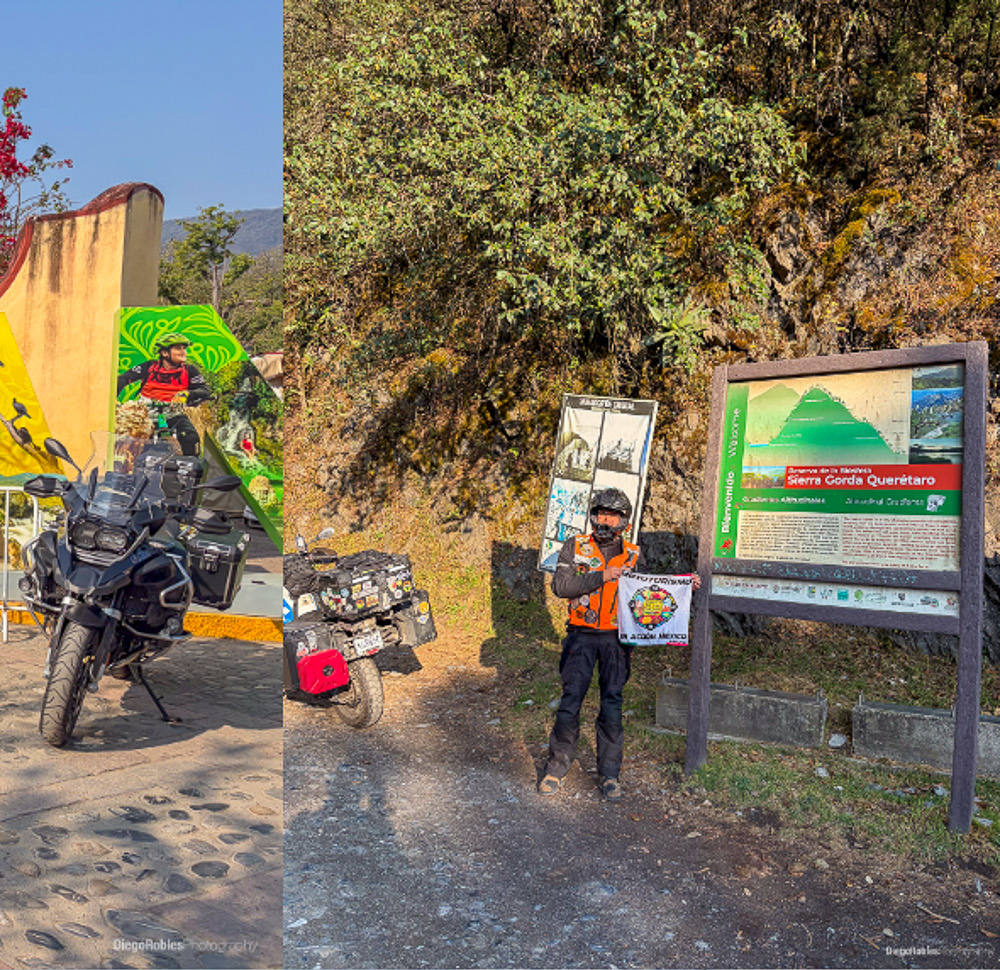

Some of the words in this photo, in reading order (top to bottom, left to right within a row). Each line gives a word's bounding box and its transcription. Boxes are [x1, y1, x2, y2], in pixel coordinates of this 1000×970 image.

[787, 474, 821, 486] Sierra
[825, 475, 863, 486] Gorda
[867, 474, 936, 488] Querétaro
[721, 470, 735, 533] Bienvenido
